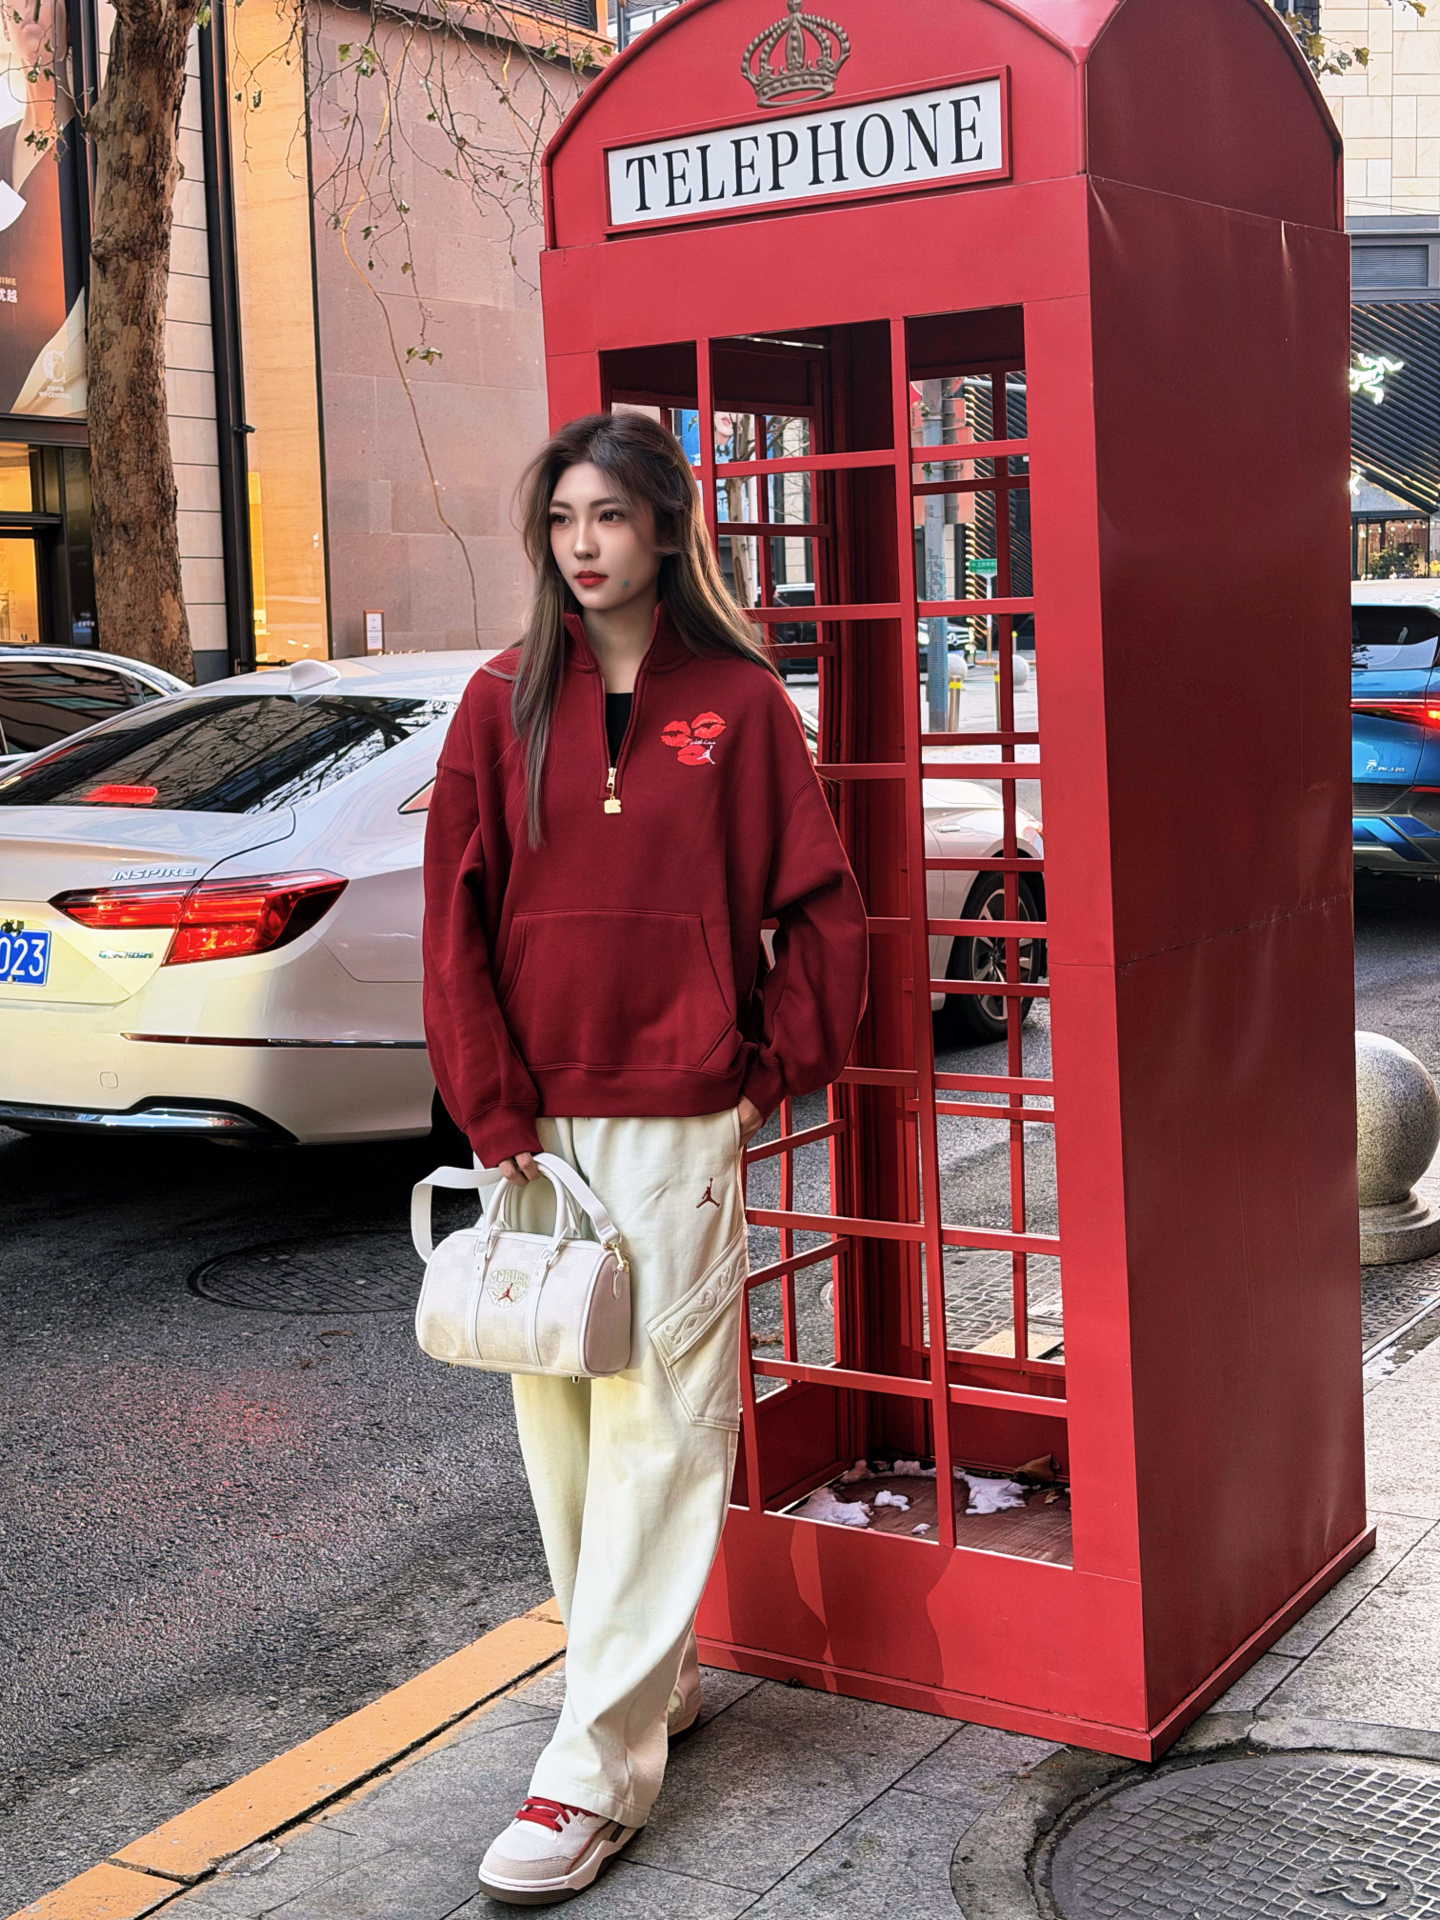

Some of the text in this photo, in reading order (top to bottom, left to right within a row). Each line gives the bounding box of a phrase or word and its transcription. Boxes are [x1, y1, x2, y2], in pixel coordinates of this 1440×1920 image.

[626, 95, 984, 212] TELEPHONE
[112, 867, 198, 881] INSPIRE
[0, 937, 45, 977] 023
